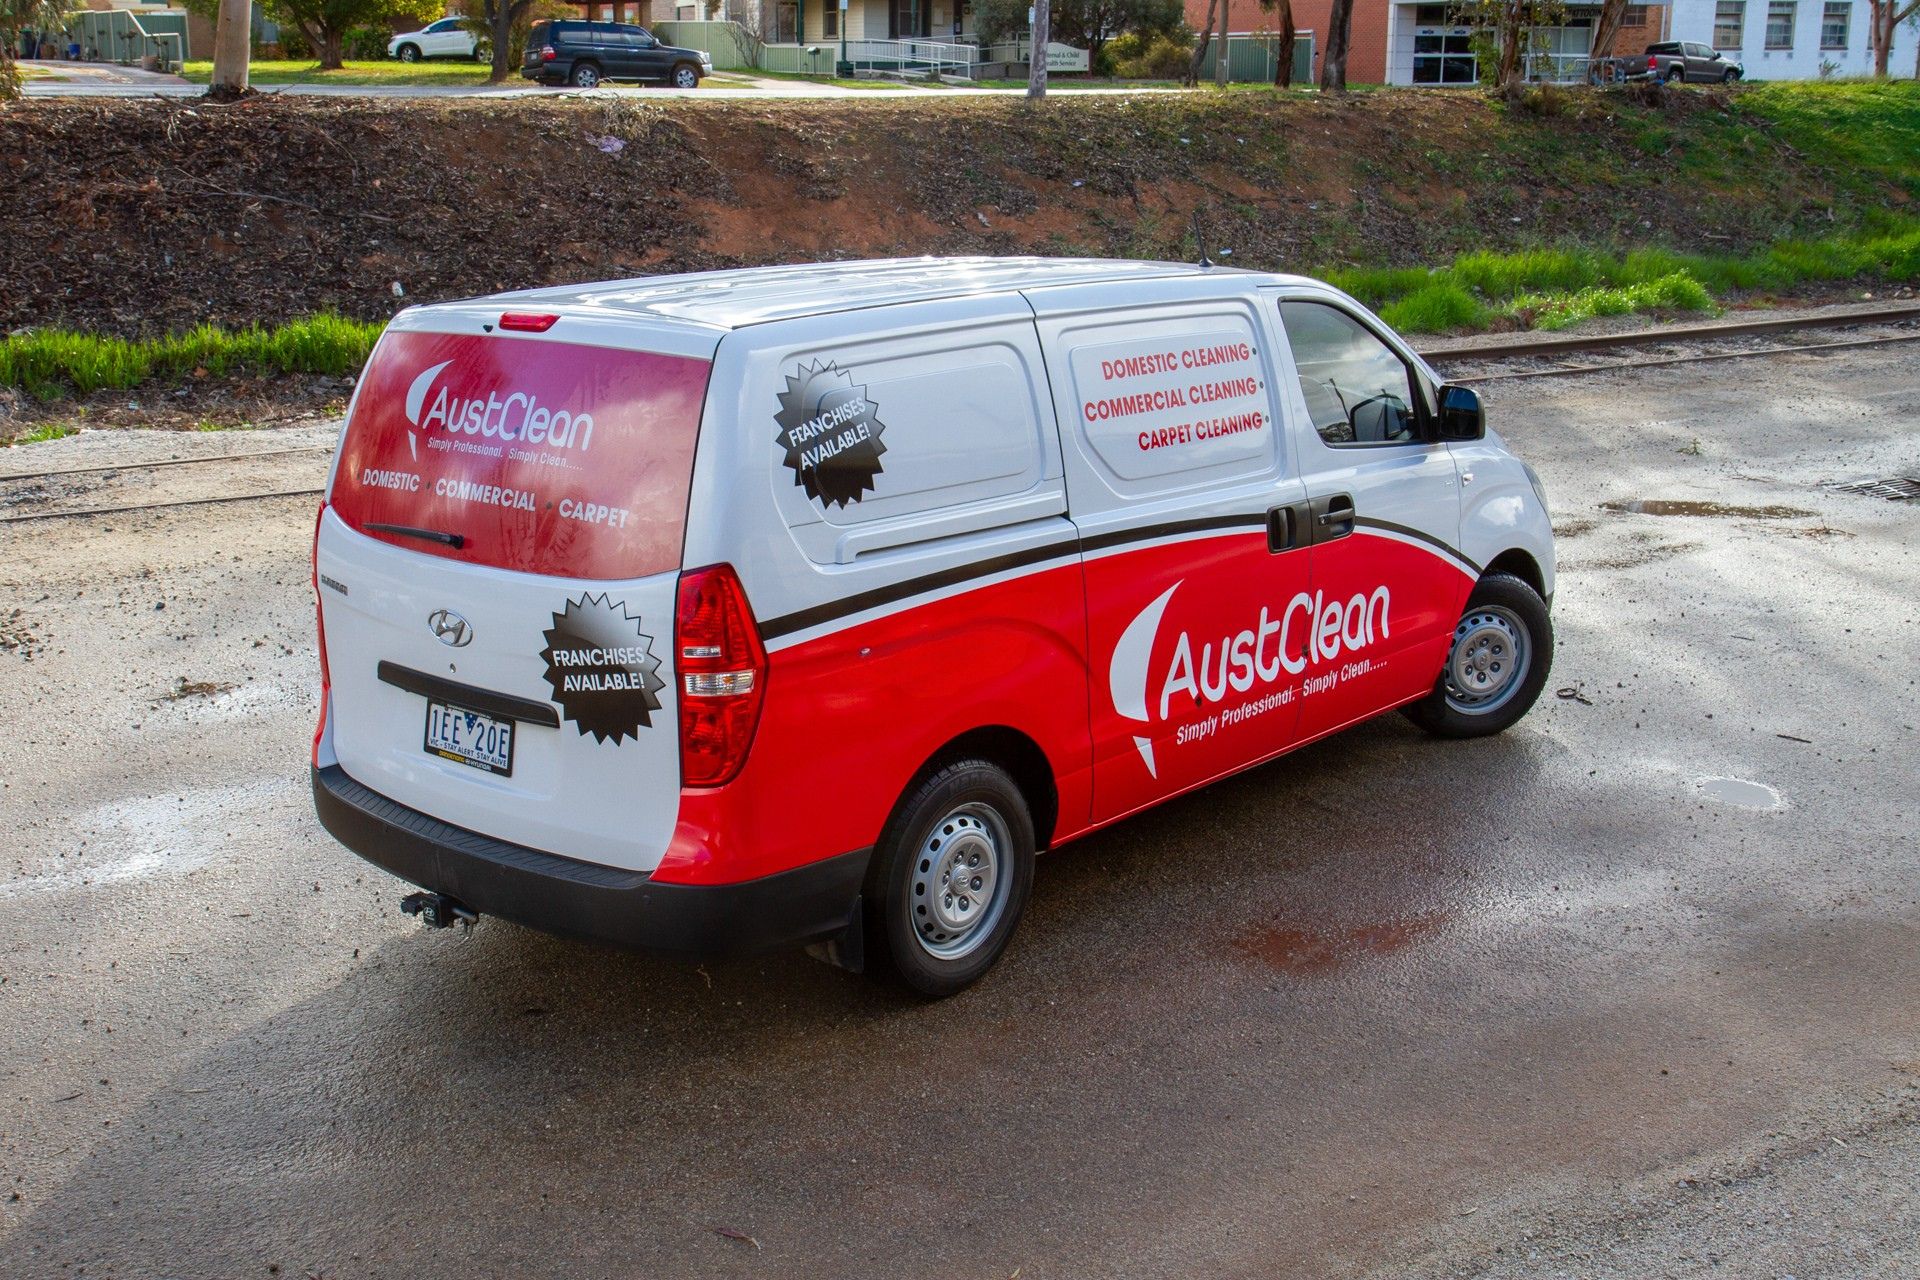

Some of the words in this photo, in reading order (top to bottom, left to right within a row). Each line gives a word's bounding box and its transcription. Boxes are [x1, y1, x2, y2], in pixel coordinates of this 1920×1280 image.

[1102, 352, 1178, 381] DOMESTIC
[1181, 343, 1250, 369] CLEANING
[422, 385, 594, 451] AustClean
[788, 396, 866, 447] FRANCHISES
[1084, 387, 1187, 422] COMMERCIAL
[1189, 377, 1257, 405] CLEANING
[427, 437, 451, 452] Simply
[508, 448, 537, 465] Simply
[801, 422, 872, 471] AVAILABLE!
[1138, 423, 1192, 451] CARPET
[1195, 411, 1263, 440] CLEANING
[362, 468, 421, 491] DOMESTIC
[435, 478, 536, 512] COMMERCIAL
[558, 499, 629, 528] CARPET
[552, 647, 645, 667] FRANCHISES
[1160, 585, 1390, 721] AustClean
[563, 672, 646, 692] AVAILABLE!
[1176, 716, 1218, 745] Simply
[1303, 669, 1338, 697] Simply
[430, 738, 439, 747] VIC
[444, 742, 457, 751] STAY
[458, 745, 474, 757] ALERT
[476, 752, 490, 762] STAY
[490, 757, 507, 767] ALIVE
